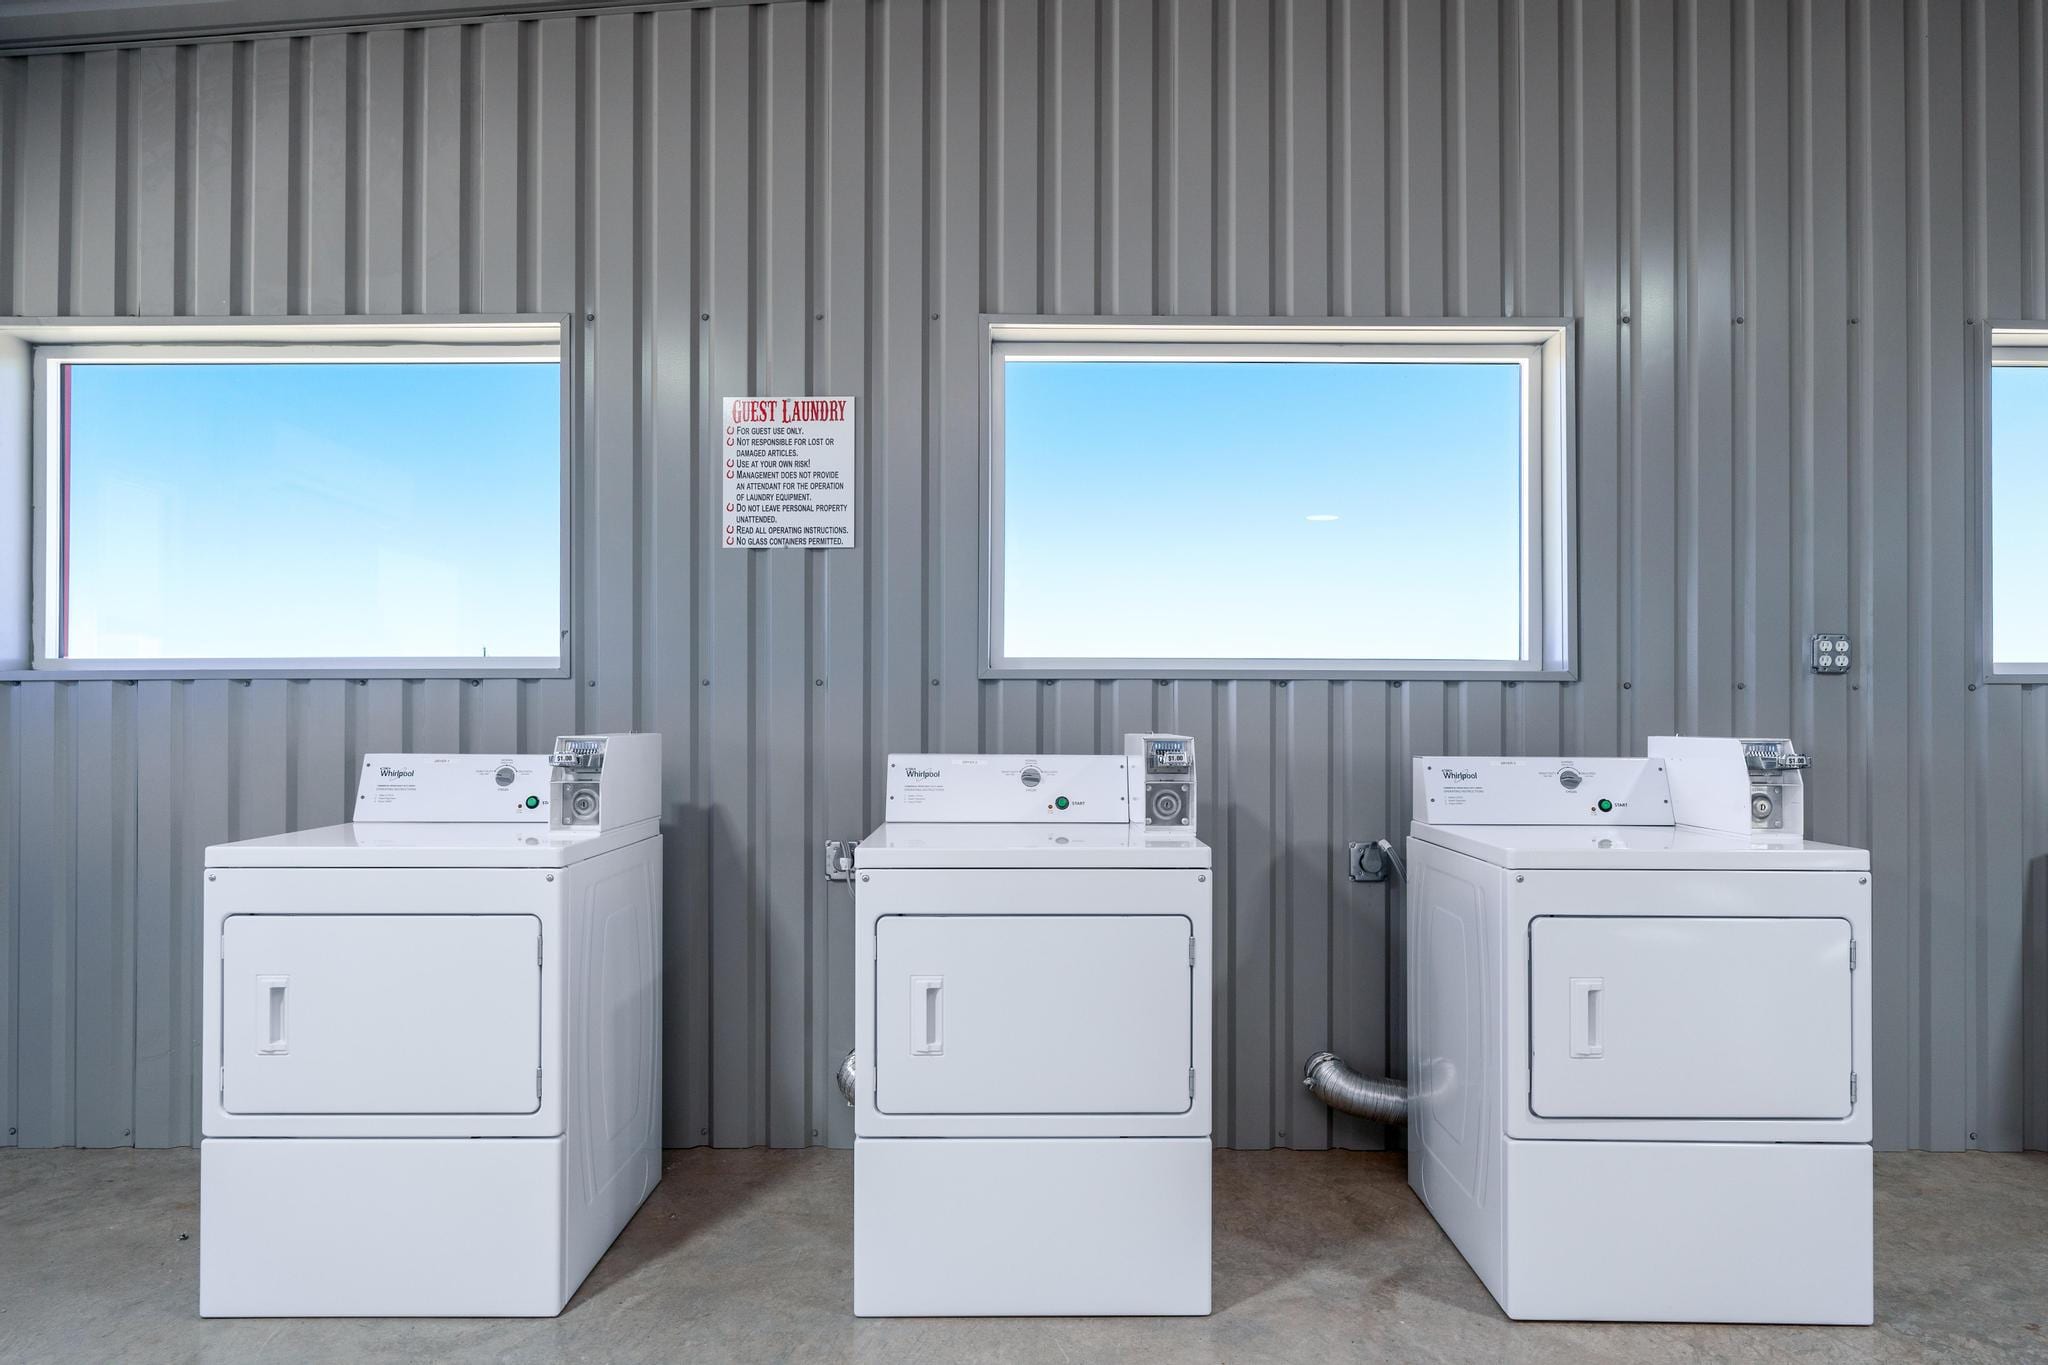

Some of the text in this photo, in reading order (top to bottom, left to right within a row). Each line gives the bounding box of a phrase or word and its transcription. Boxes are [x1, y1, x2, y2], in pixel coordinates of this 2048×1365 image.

[732, 399, 847, 423] GUEST LAUNDRY
[736, 426, 804, 435] FOR GUEST USE ONLY.
[736, 437, 835, 446] NOT RESPONSIBLE FOR LOST OR
[736, 449, 799, 457] DAMAGED ARTICLES.
[736, 459, 811, 468] USE AT YOUR OWN RISK!
[736, 471, 839, 479] MANAGEMENT DOES NOT PROVIDE
[736, 482, 844, 490] AN ATTENDANT FOR THE OPERATION
[736, 493, 812, 501] OF LAUNDRY EQUIPMENT.
[736, 503, 848, 512] DO NOT LEAVE PERSONAL PROPERTY
[736, 515, 777, 524] UNATTENDED.
[736, 525, 849, 535] READ ALL OPERATING INSTRUCTIONS.
[736, 537, 844, 546] NO GLASS CONTAINERS PERMITTED.
[380, 769, 415, 779] Whirlpool
[906, 770, 941, 779] Whirlpool
[1443, 771, 1478, 781] Whirlpool
